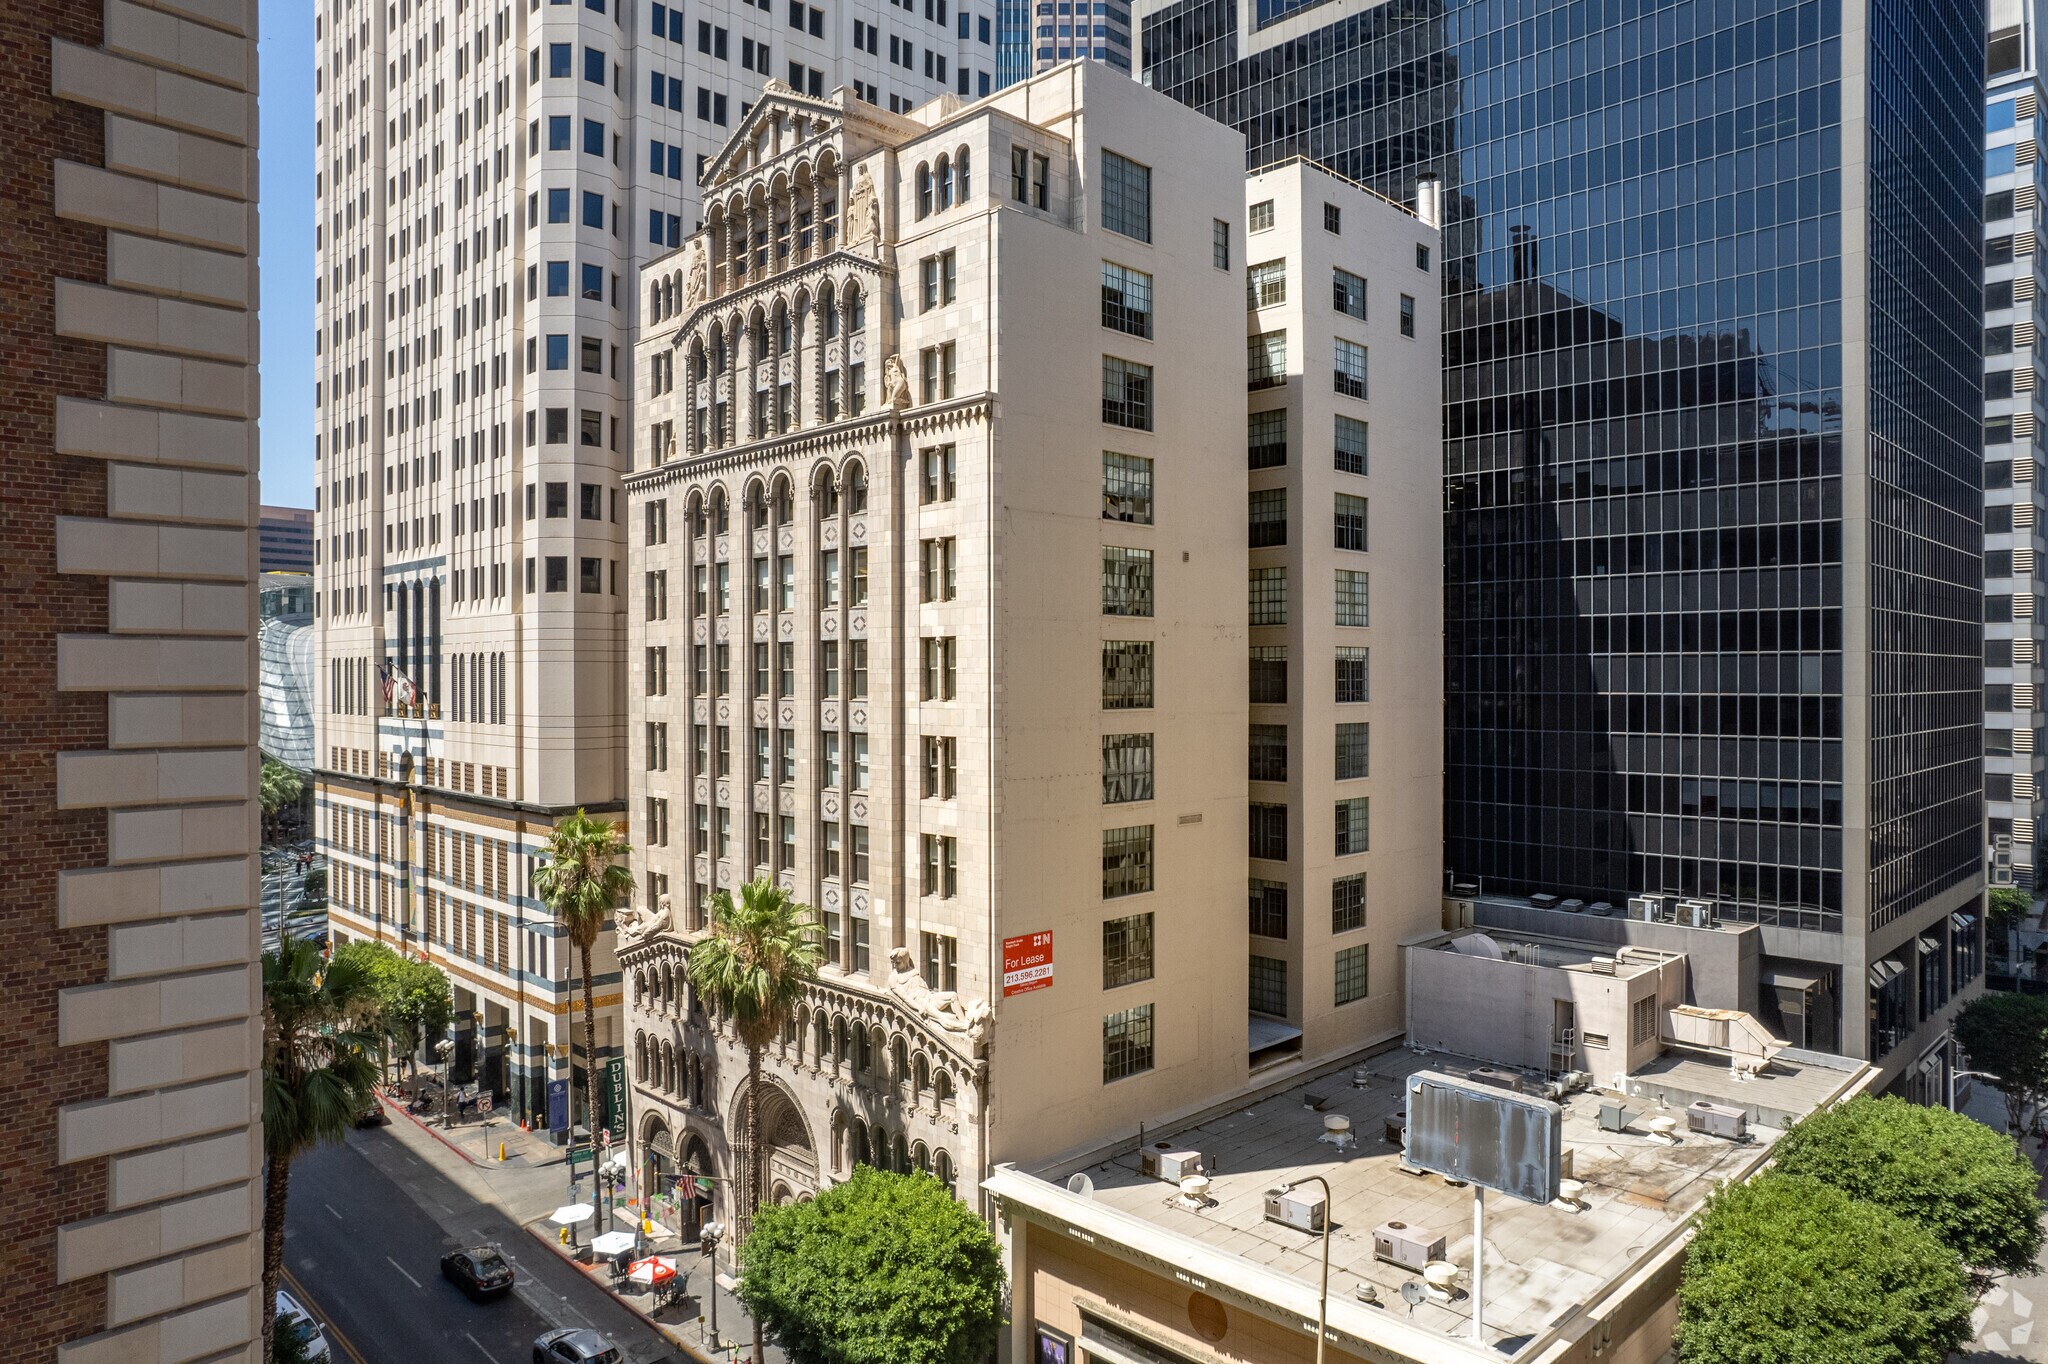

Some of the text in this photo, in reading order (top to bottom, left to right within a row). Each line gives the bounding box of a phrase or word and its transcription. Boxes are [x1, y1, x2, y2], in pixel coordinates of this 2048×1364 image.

[1006, 954, 1044, 969] For Lease
[1006, 967, 1050, 983] 213.596.2281
[611, 1062, 625, 1133] DUBLIN'S
